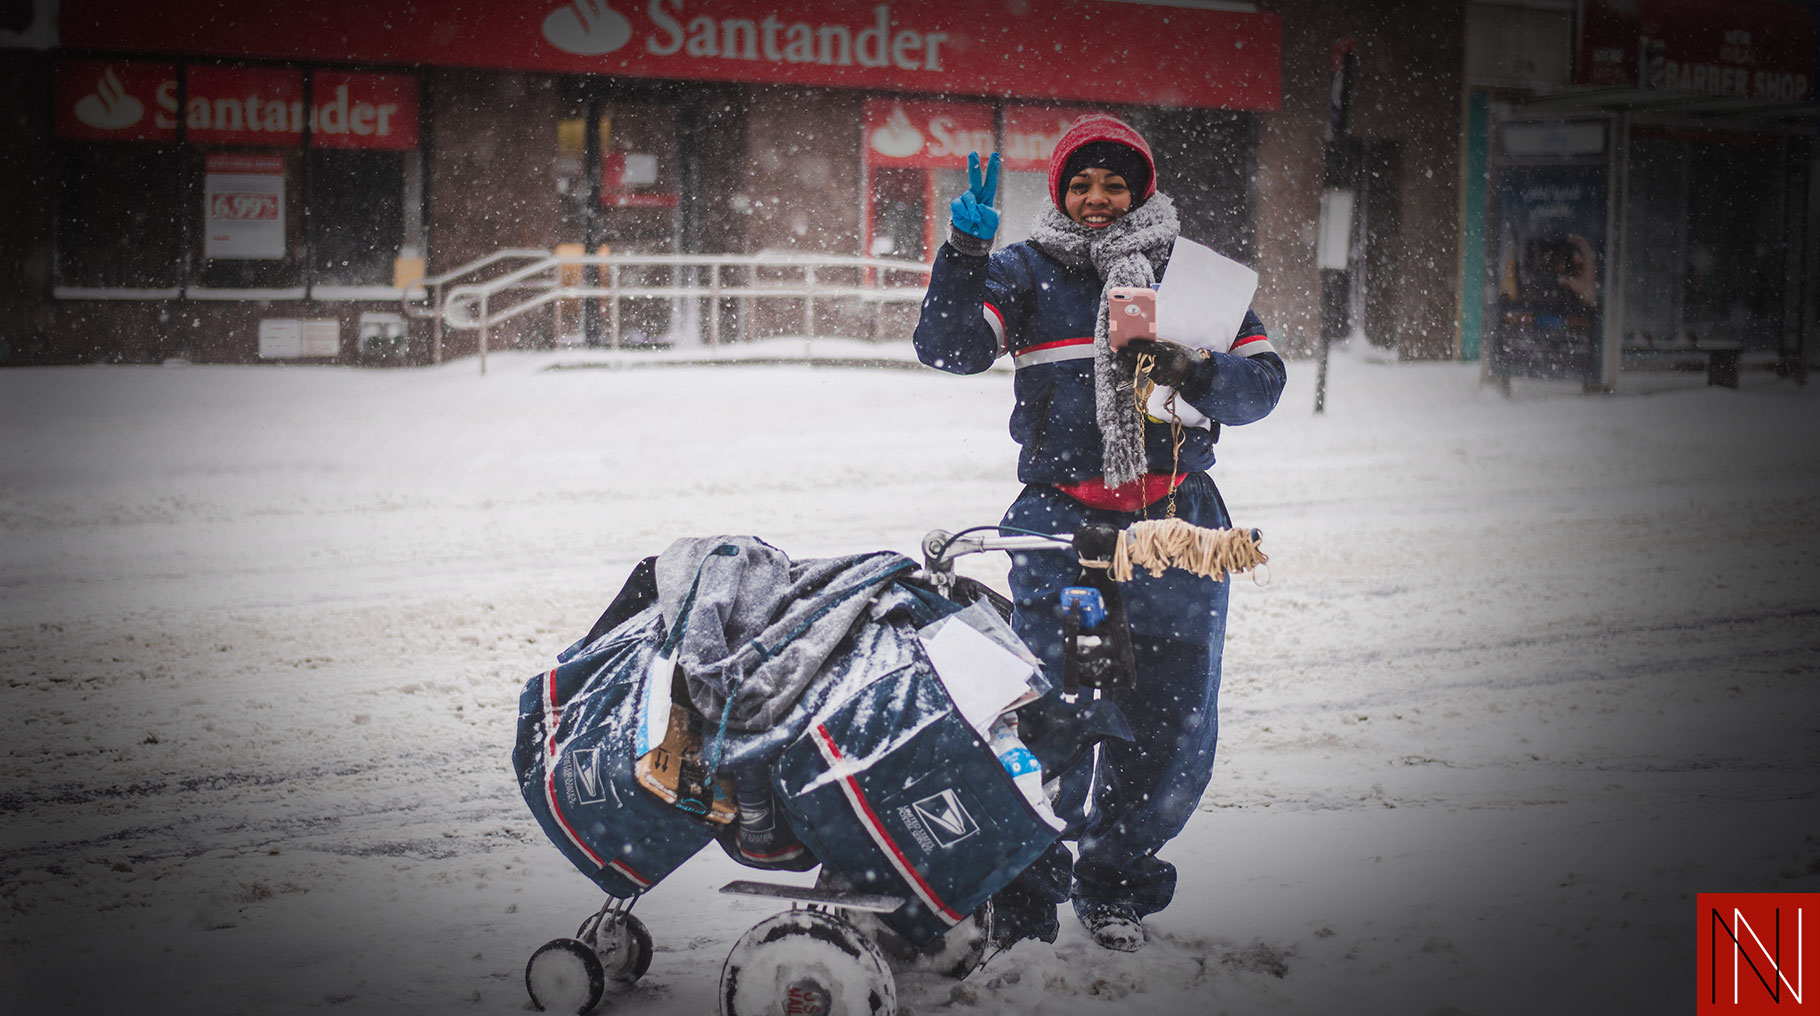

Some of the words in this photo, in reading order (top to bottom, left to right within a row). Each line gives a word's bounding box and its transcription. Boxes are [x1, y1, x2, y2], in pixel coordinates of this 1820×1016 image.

[646, 0, 947, 71] Santander
[1664, 61, 1749, 98] BARBER
[1753, 72, 1810, 102] SHOP
[155, 80, 398, 136] Santander
[929, 116, 1070, 160] Sanand
[896, 806, 915, 831] POSTAL
[903, 805, 922, 830] UNITED
[918, 828, 936, 849] STATES
[787, 987, 803, 1015] MAIL
